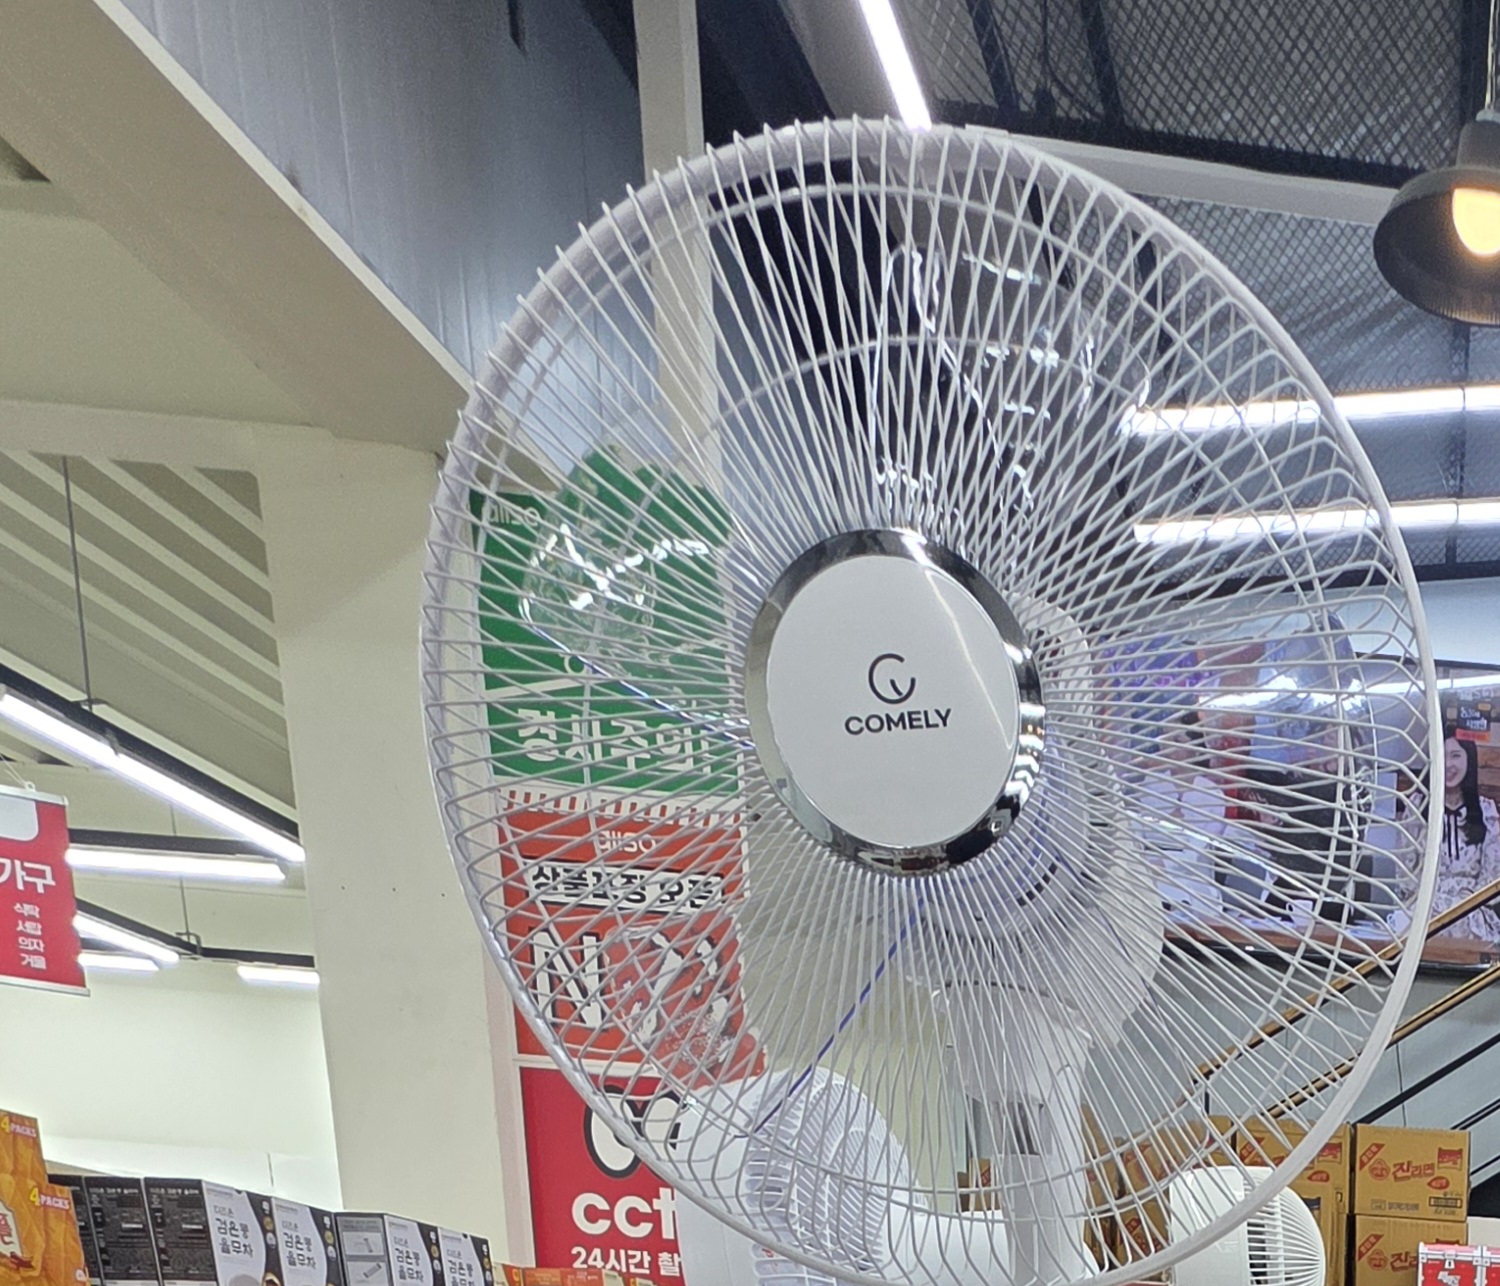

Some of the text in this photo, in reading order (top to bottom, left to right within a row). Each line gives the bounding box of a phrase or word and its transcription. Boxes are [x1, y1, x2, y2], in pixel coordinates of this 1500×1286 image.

[844, 707, 951, 736] COMELY
[18, 937, 44, 952] 의자
[1392, 1160, 1435, 1183] 진라면
[571, 1246, 651, 1275] 24시간
